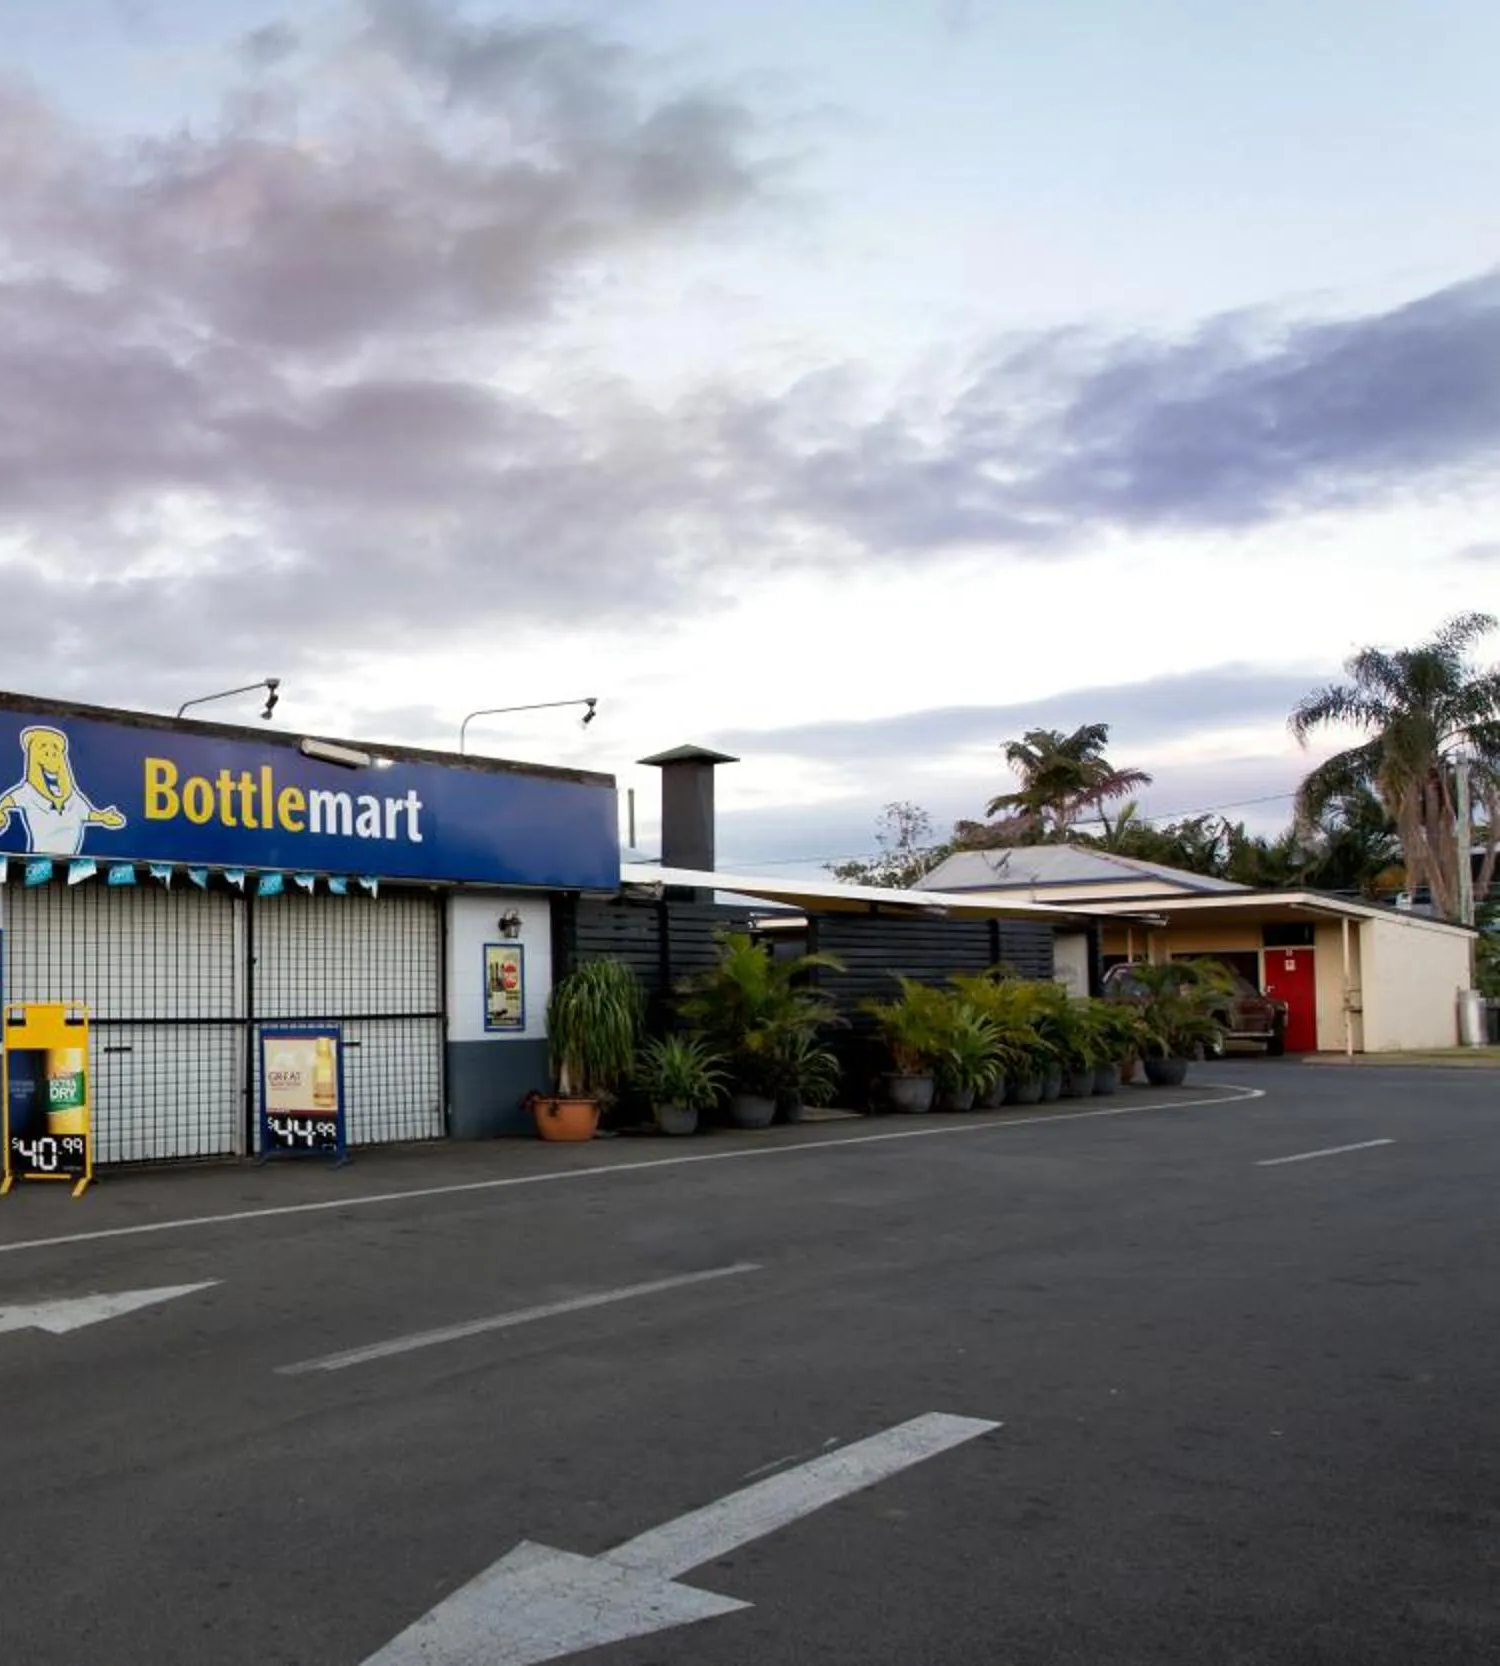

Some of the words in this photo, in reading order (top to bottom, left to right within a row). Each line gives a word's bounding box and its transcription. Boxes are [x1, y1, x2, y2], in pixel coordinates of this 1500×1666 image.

[143, 756, 424, 843] Bottlemart
[49, 1087, 77, 1100] DRY
[11, 1137, 84, 1171] $40.99
